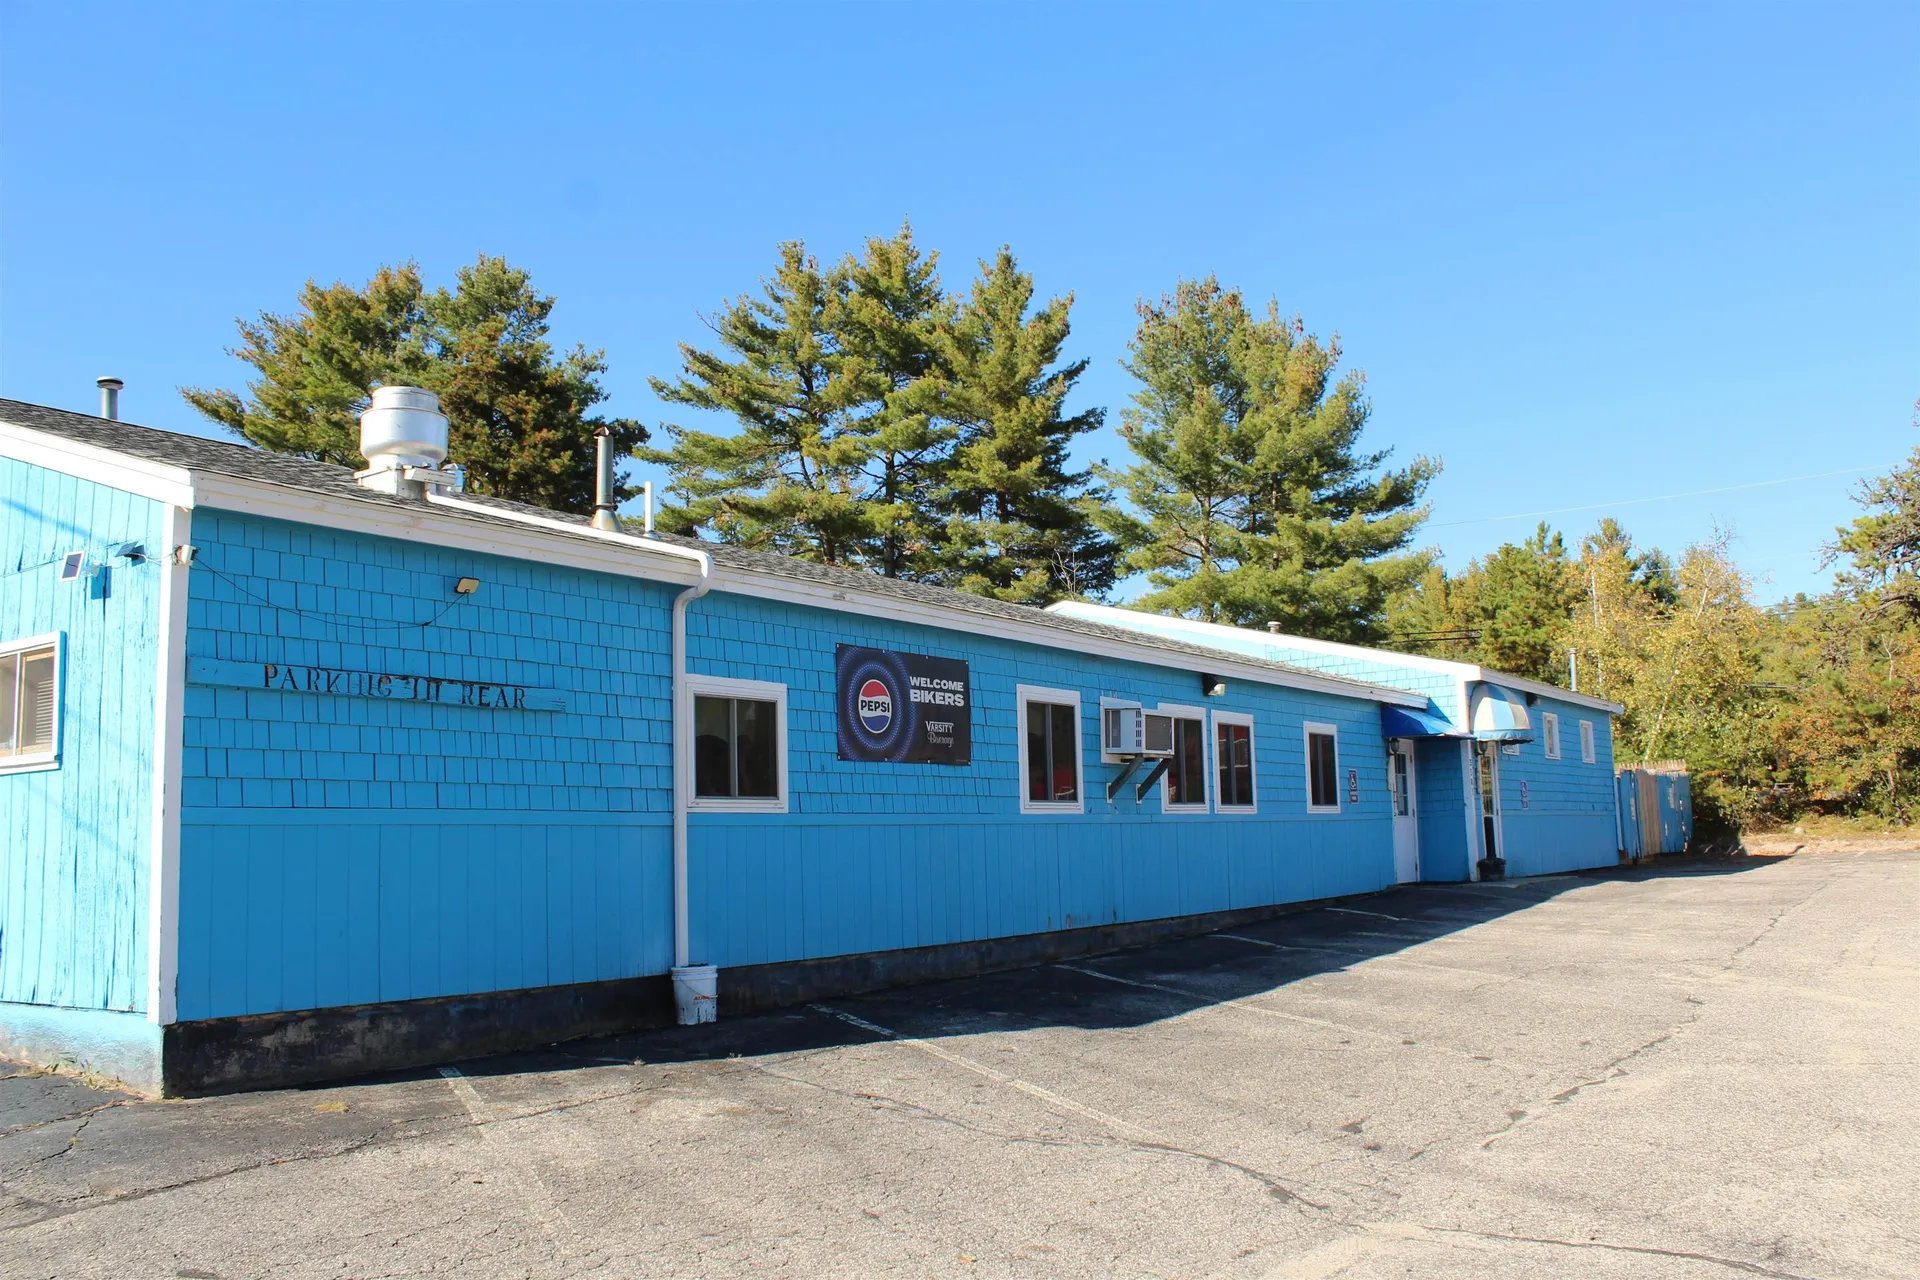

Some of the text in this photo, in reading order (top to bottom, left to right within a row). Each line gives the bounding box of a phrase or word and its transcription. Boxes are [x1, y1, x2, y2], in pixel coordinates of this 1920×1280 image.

[909, 676, 964, 691] WELCOME
[459, 682, 527, 709] REAR
[910, 689, 965, 707] BIKERS
[860, 700, 890, 713] PEPSI
